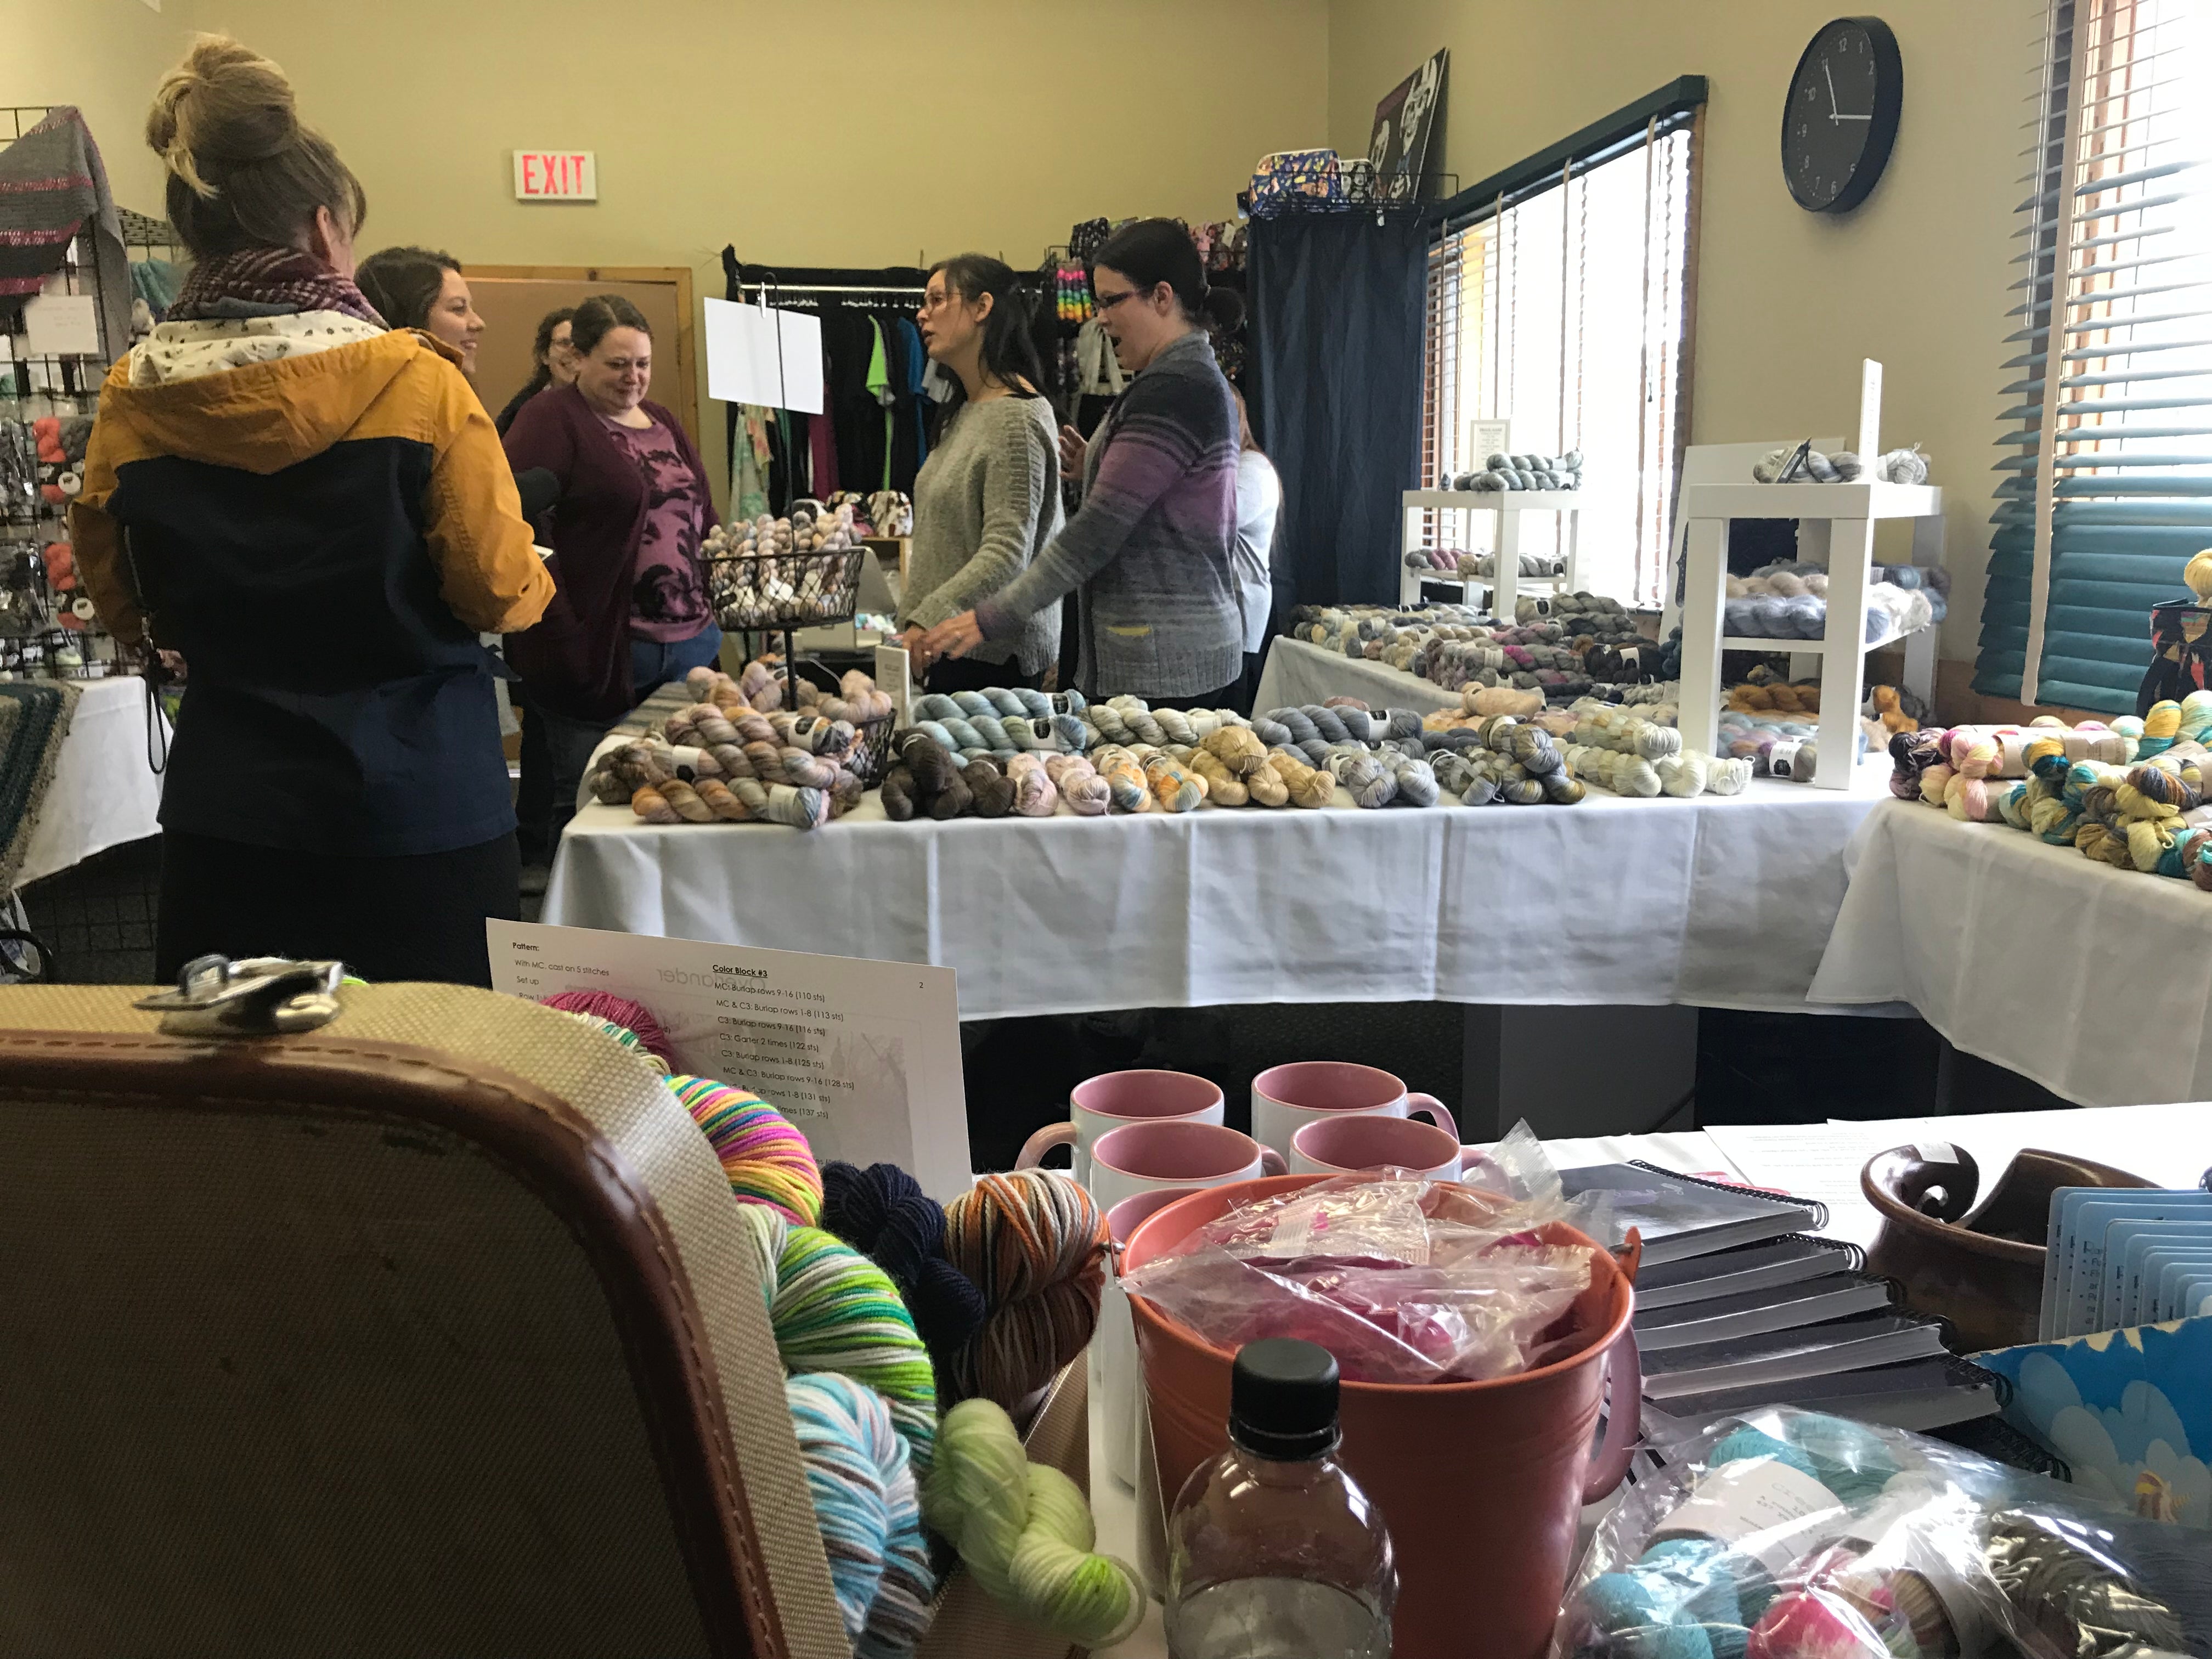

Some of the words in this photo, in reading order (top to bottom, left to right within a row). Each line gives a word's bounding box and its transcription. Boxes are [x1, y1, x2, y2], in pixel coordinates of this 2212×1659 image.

[523, 154, 585, 194] EXIT
[512, 942, 540, 951] Pattern:
[583, 967, 610, 976] stitches
[713, 964, 732, 973] Color
[735, 967, 755, 976] Block
[732, 984, 756, 994] Burlap
[777, 989, 793, 998] 9-16
[796, 991, 811, 1000] (110
[813, 994, 825, 1003] sts)
[754, 1003, 778, 1013] Burlap
[801, 1009, 811, 1017] 1-8
[814, 1011, 830, 1019] (113
[832, 1013, 843, 1022] sts)
[733, 1018, 757, 1028] Burlap
[777, 1023, 794, 1032] 9-16
[796, 1025, 811, 1034] (116
[814, 1028, 825, 1037] sts)
[720, 1033, 732, 1041] C3:
[734, 1035, 759, 1044] Garter
[768, 1039, 788, 1048] times
[790, 1041, 805, 1050] (122
[808, 1043, 819, 1053] sts)
[721, 1049, 735, 1058] C3:
[736, 1052, 760, 1062] Burlap
[782, 1057, 793, 1065] 1-8
[795, 1059, 810, 1067] (125
[812, 1061, 824, 1070] sts)
[761, 1071, 785, 1081] Burlap
[806, 1076, 823, 1085] 9-16
[825, 1079, 840, 1087] (128
[843, 1081, 854, 1091] sts)
[788, 1090, 799, 1099] 1-8
[801, 1092, 816, 1101] (131
[819, 1095, 830, 1104] sts)
[799, 1108, 815, 1117] (137
[817, 1110, 828, 1119] sts)
